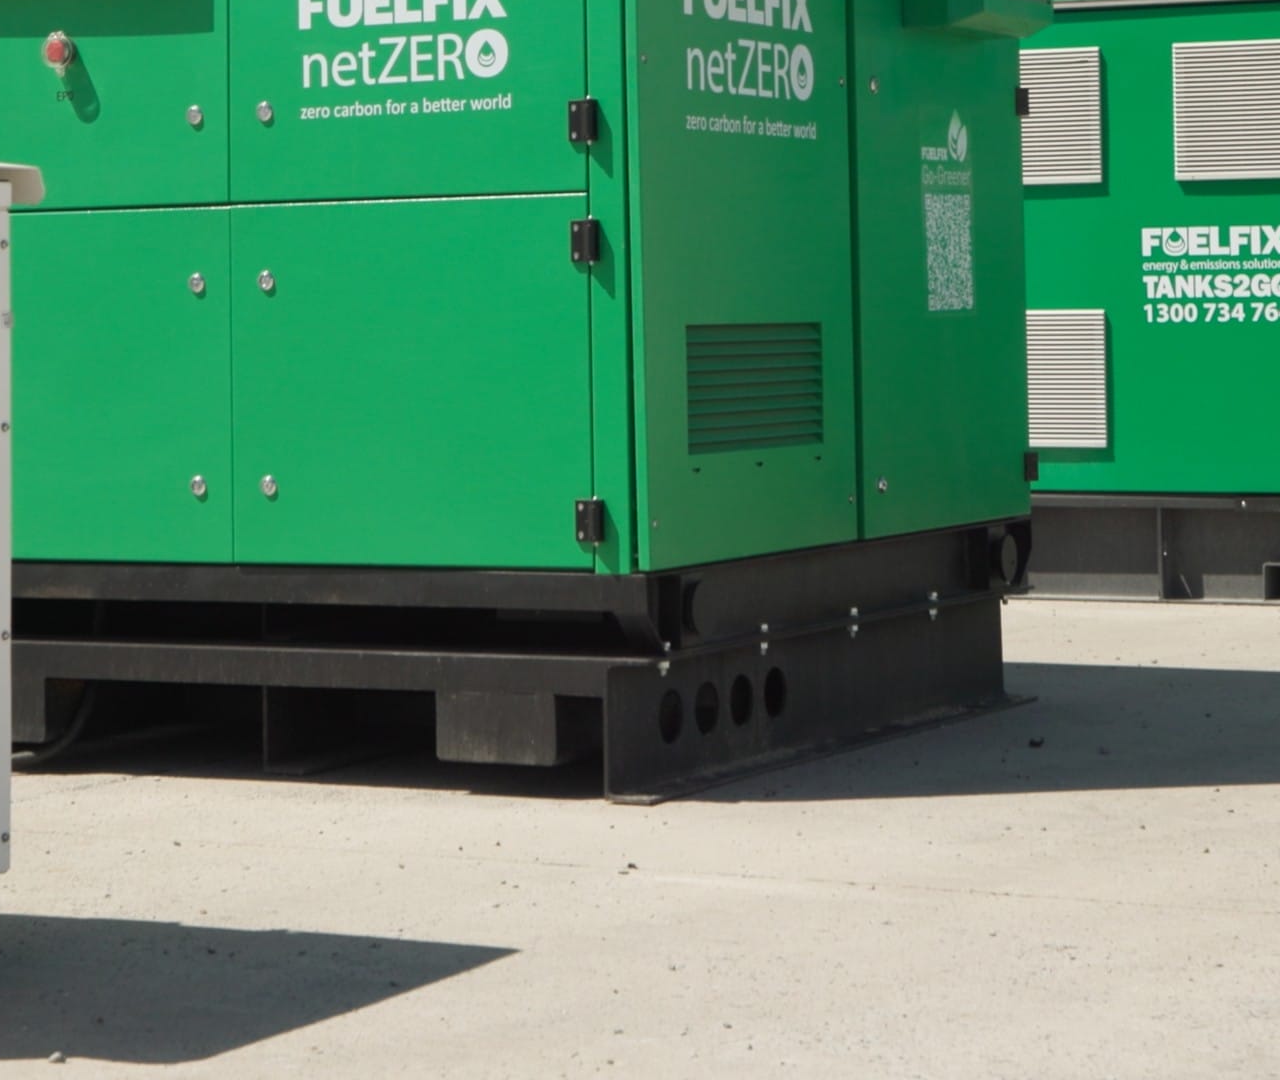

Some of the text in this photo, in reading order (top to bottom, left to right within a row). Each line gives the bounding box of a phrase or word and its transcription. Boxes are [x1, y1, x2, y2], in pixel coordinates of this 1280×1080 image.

[303, 28, 509, 88] netZERO
[686, 38, 814, 101] netZERO
[300, 93, 512, 119] zero carbon for a better world
[686, 114, 817, 140] zero carbon for a better world
[922, 164, 971, 186] Go-Greener
[1143, 260, 1178, 273] energy
[1180, 258, 1189, 270] &
[1190, 259, 1241, 270] emissions
[1143, 302, 1198, 323] 1300
[1203, 302, 1246, 322] 734
